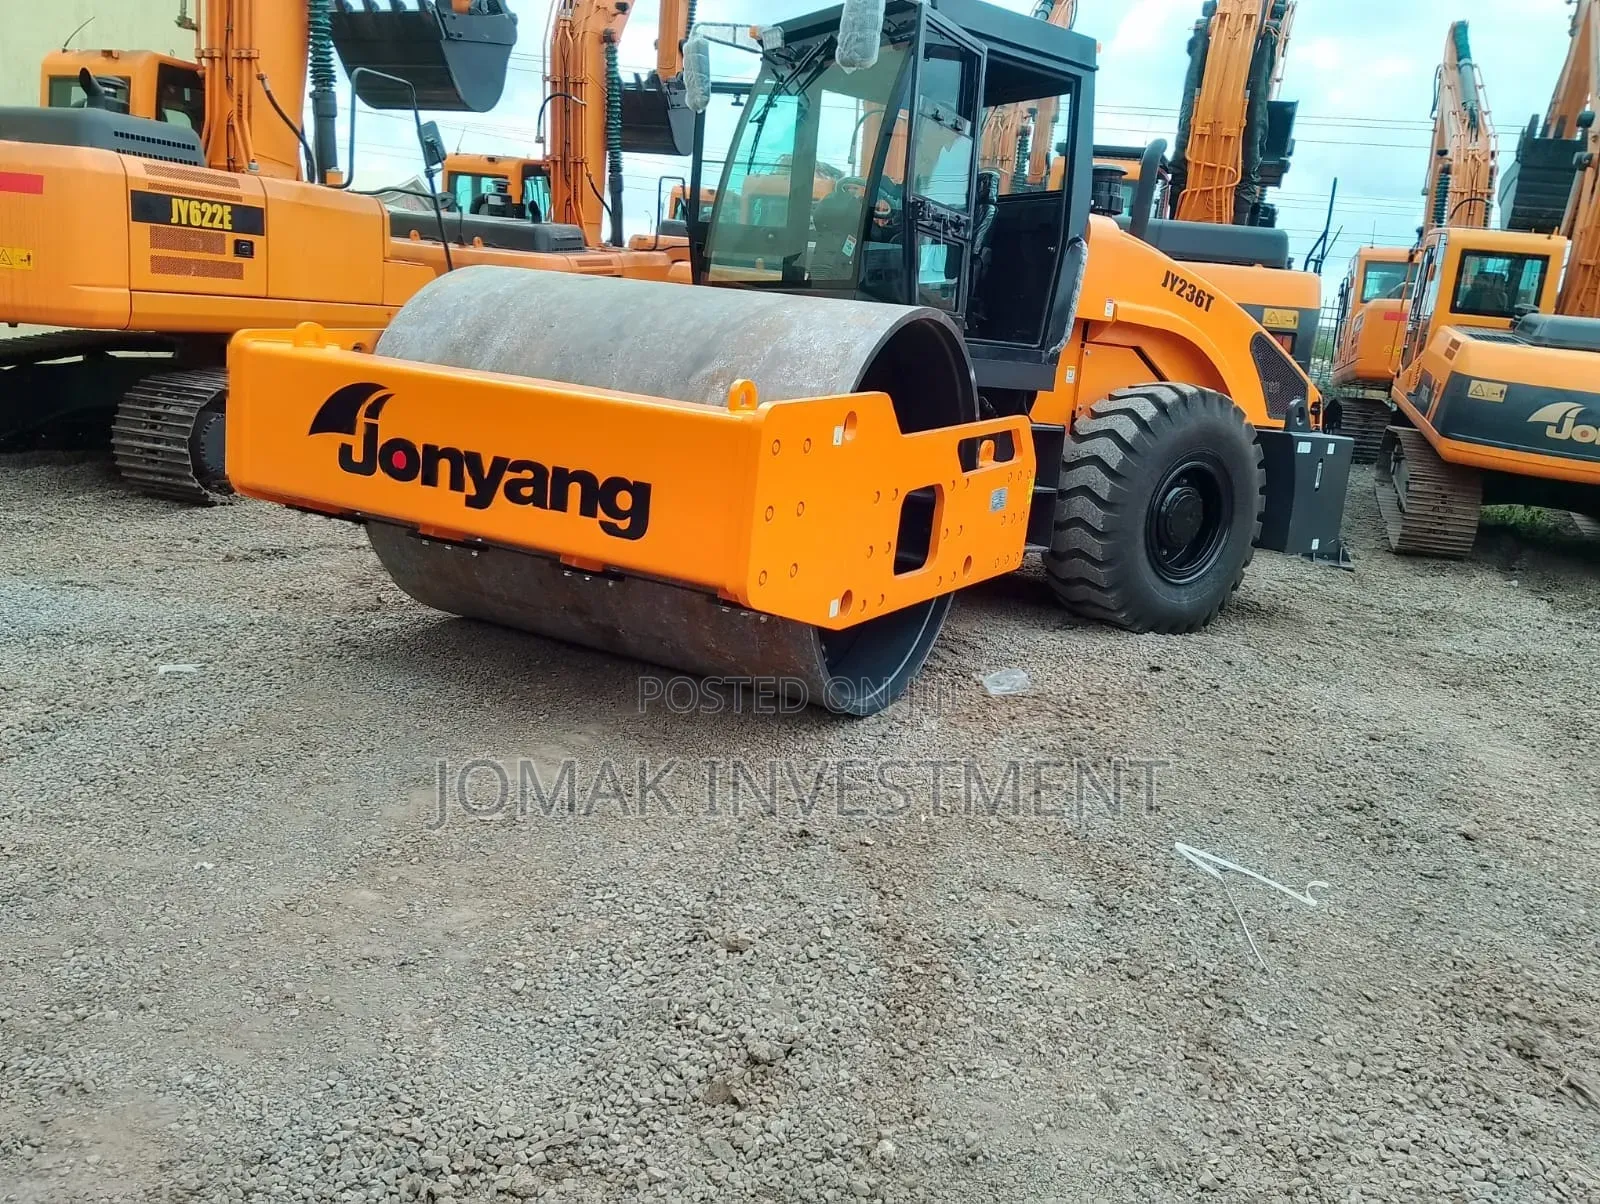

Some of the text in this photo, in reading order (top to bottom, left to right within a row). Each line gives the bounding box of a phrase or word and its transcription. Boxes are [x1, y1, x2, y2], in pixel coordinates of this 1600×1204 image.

[170, 198, 233, 230] JY622E
[1161, 269, 1216, 313] JY236T
[1545, 407, 1600, 446] Jo
[337, 415, 653, 541] Jonyang
